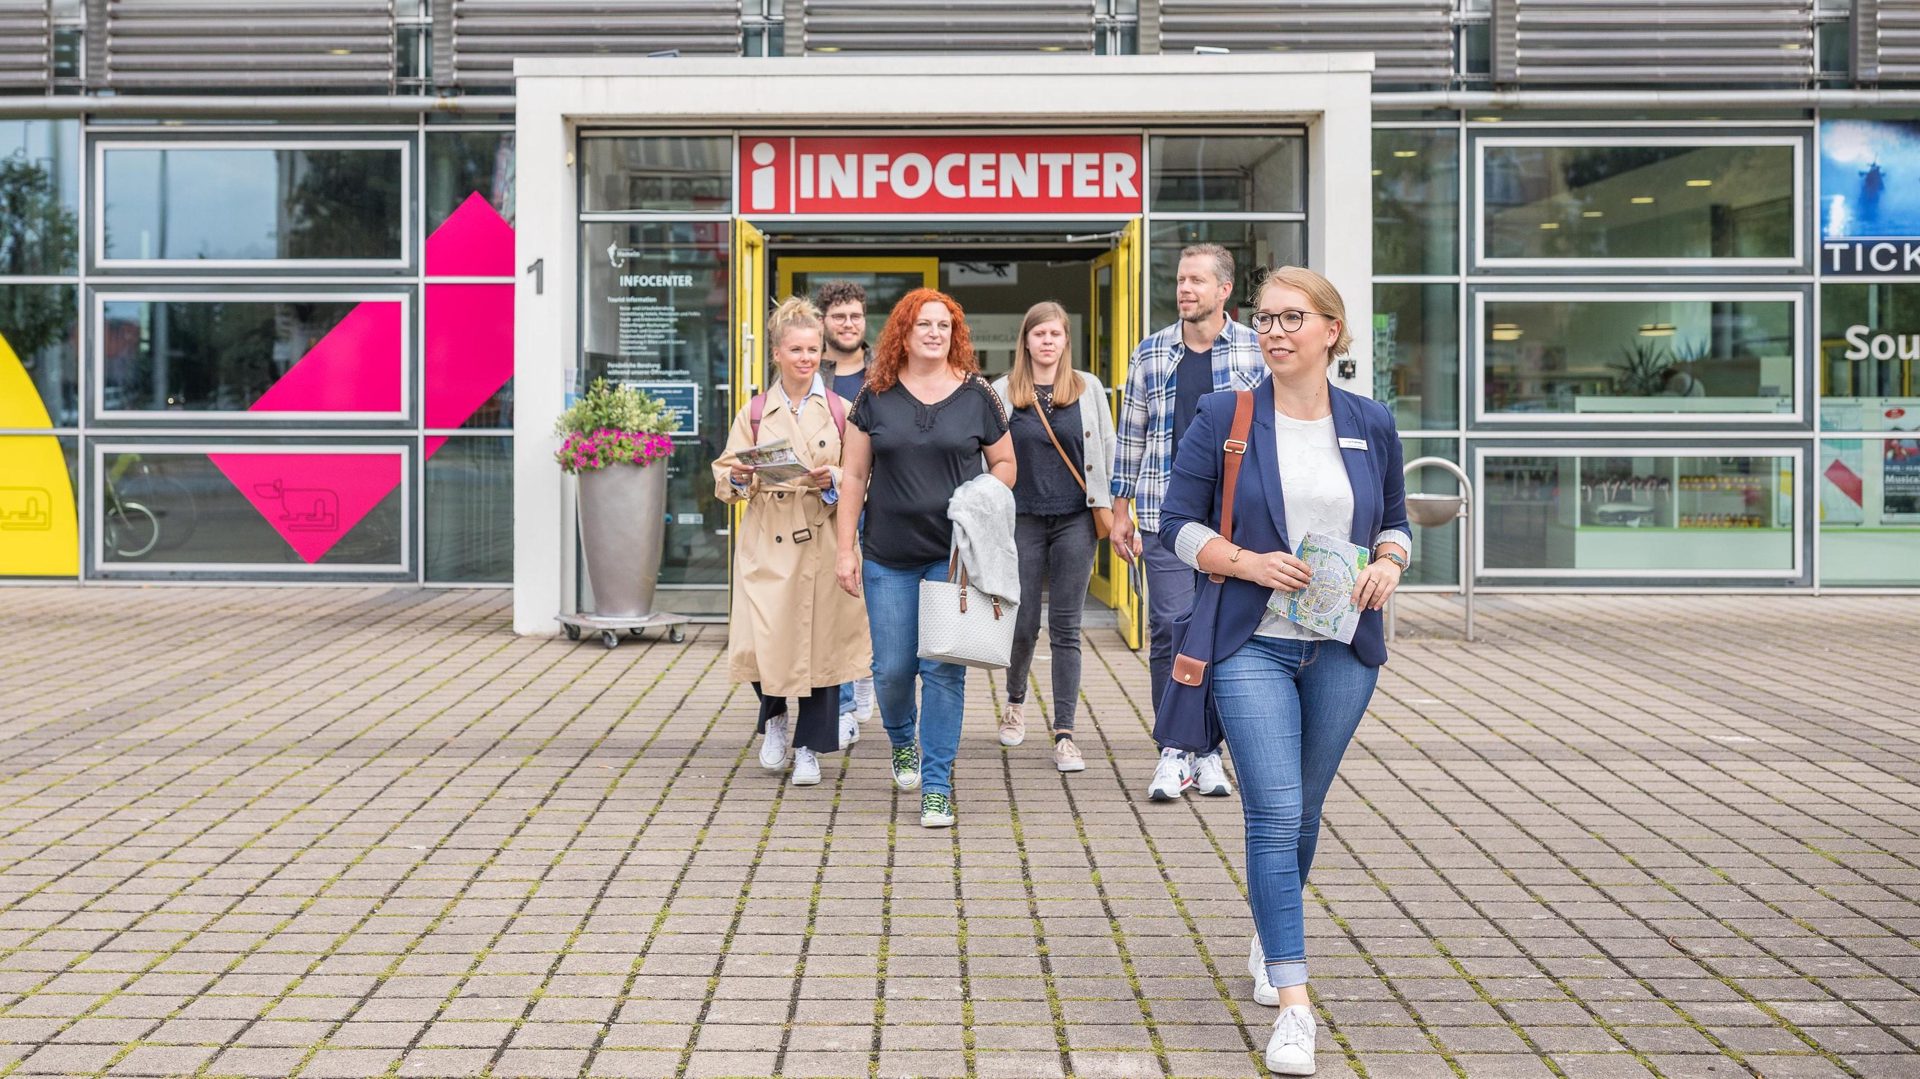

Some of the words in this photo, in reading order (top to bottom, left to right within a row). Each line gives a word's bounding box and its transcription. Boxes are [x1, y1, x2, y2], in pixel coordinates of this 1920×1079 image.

[799, 152, 1139, 199] INFOCENTER
[527, 258, 544, 295] 1
[619, 275, 693, 287] INFOCENTER
[1844, 324, 1920, 361] Sou
[1885, 474, 1920, 484] Musica
